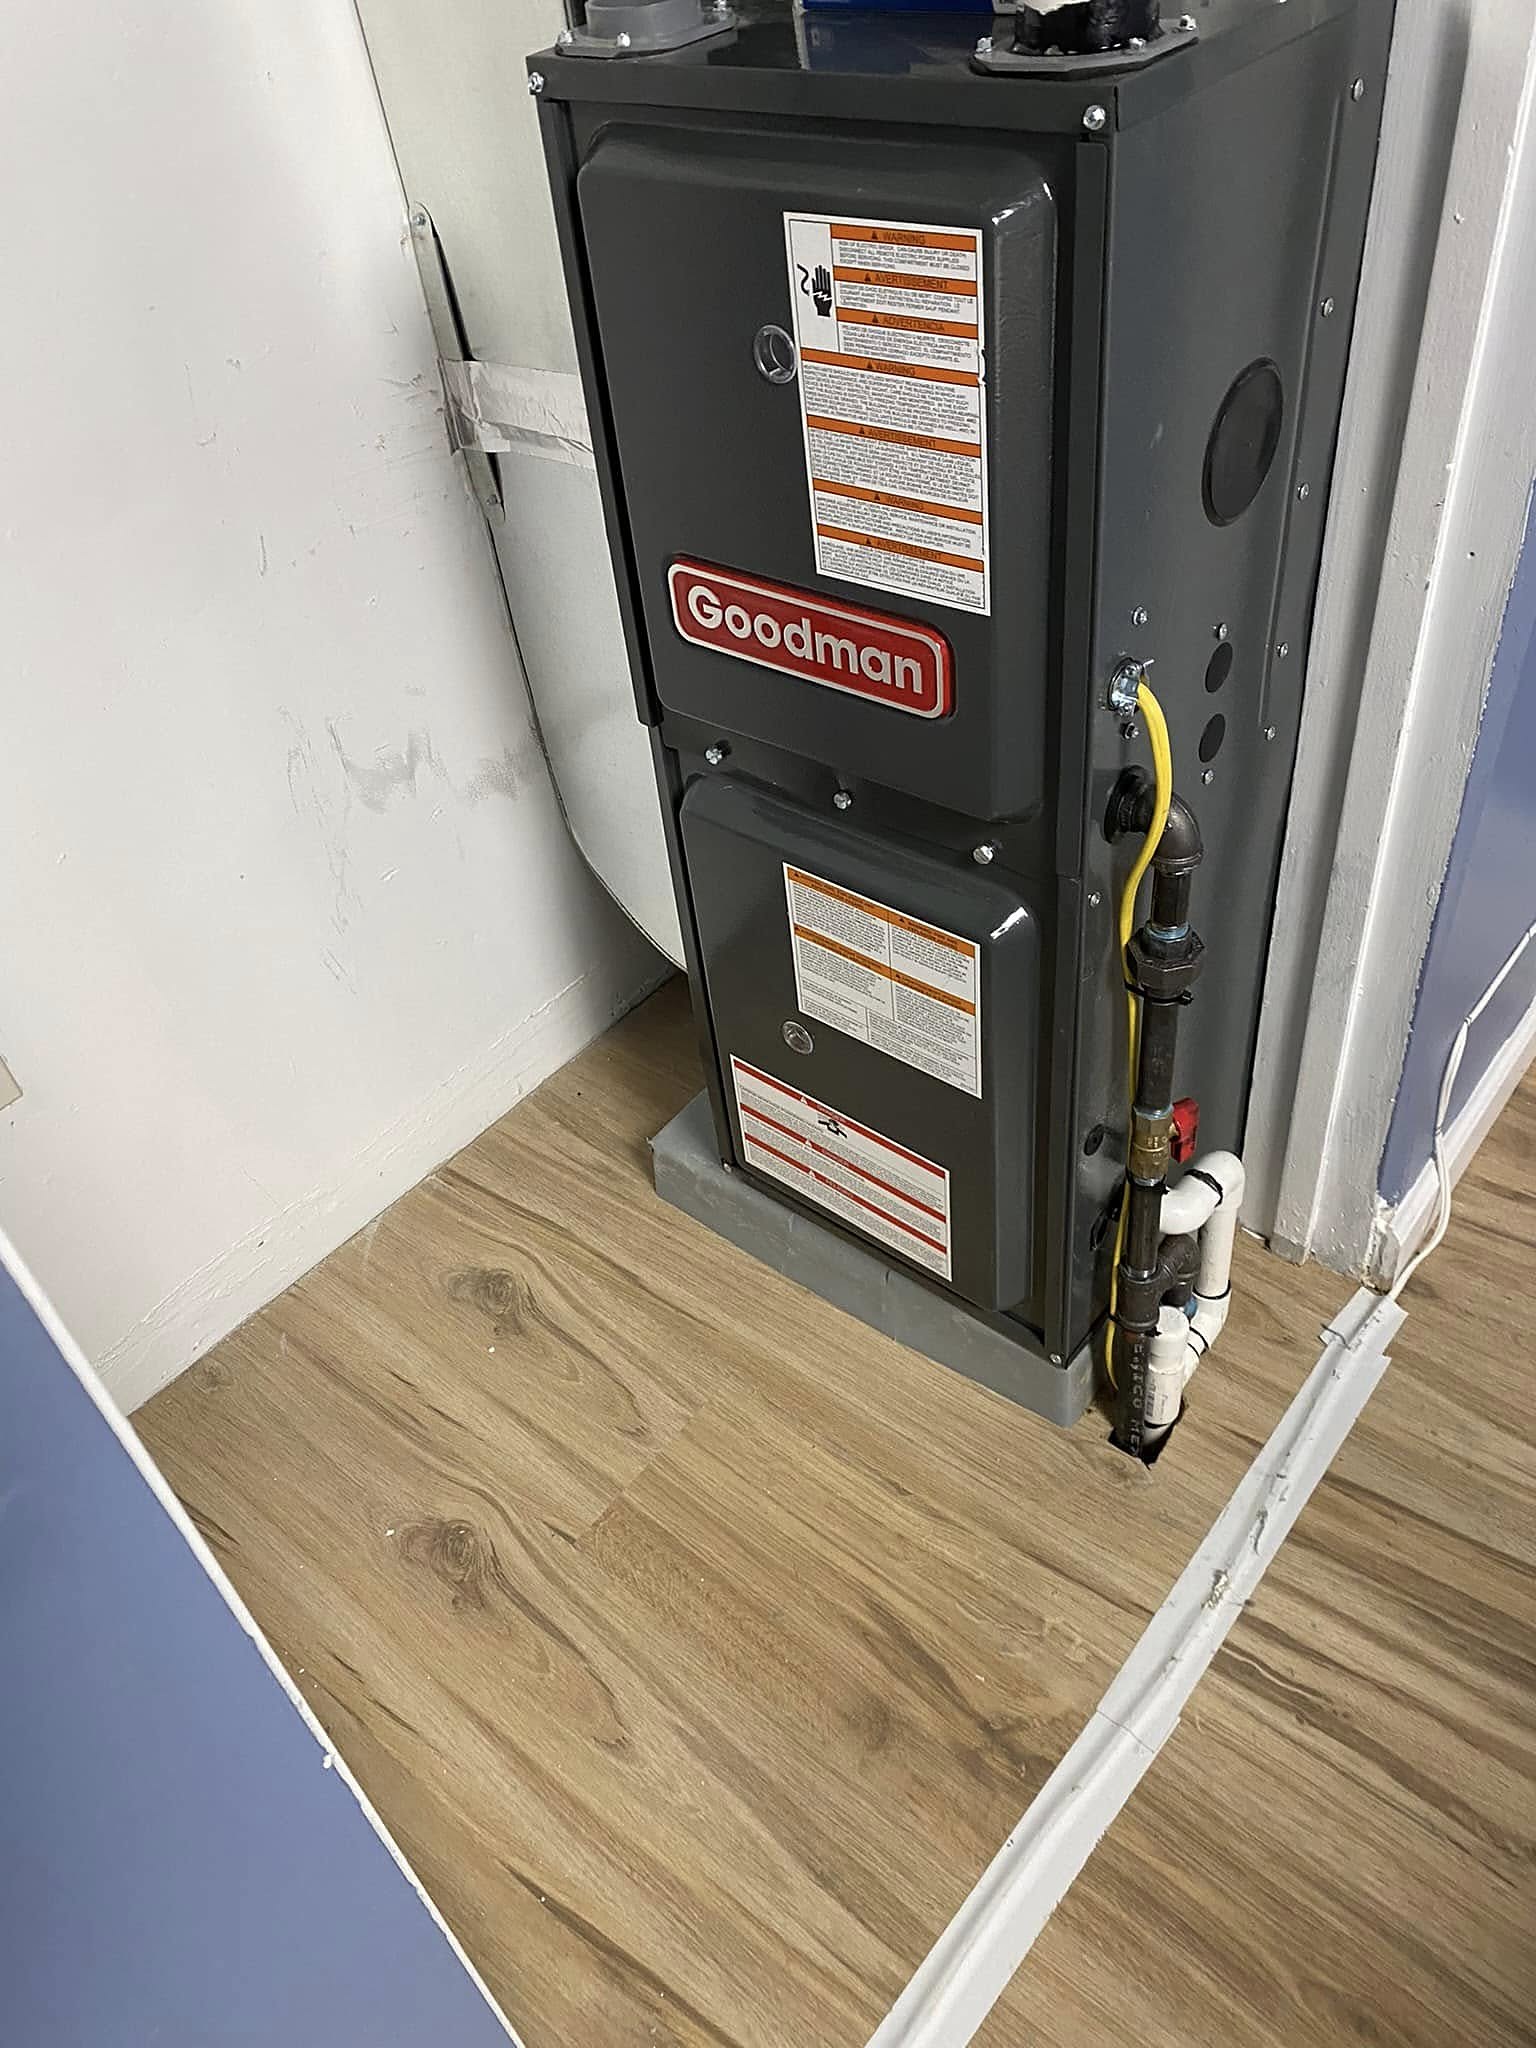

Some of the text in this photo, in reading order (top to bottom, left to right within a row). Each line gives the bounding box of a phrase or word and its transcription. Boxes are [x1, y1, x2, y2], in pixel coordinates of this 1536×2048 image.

[882, 231, 926, 245] WARNING
[883, 317, 945, 331] ADVERTENCIA
[688, 585, 922, 694] Goodman
